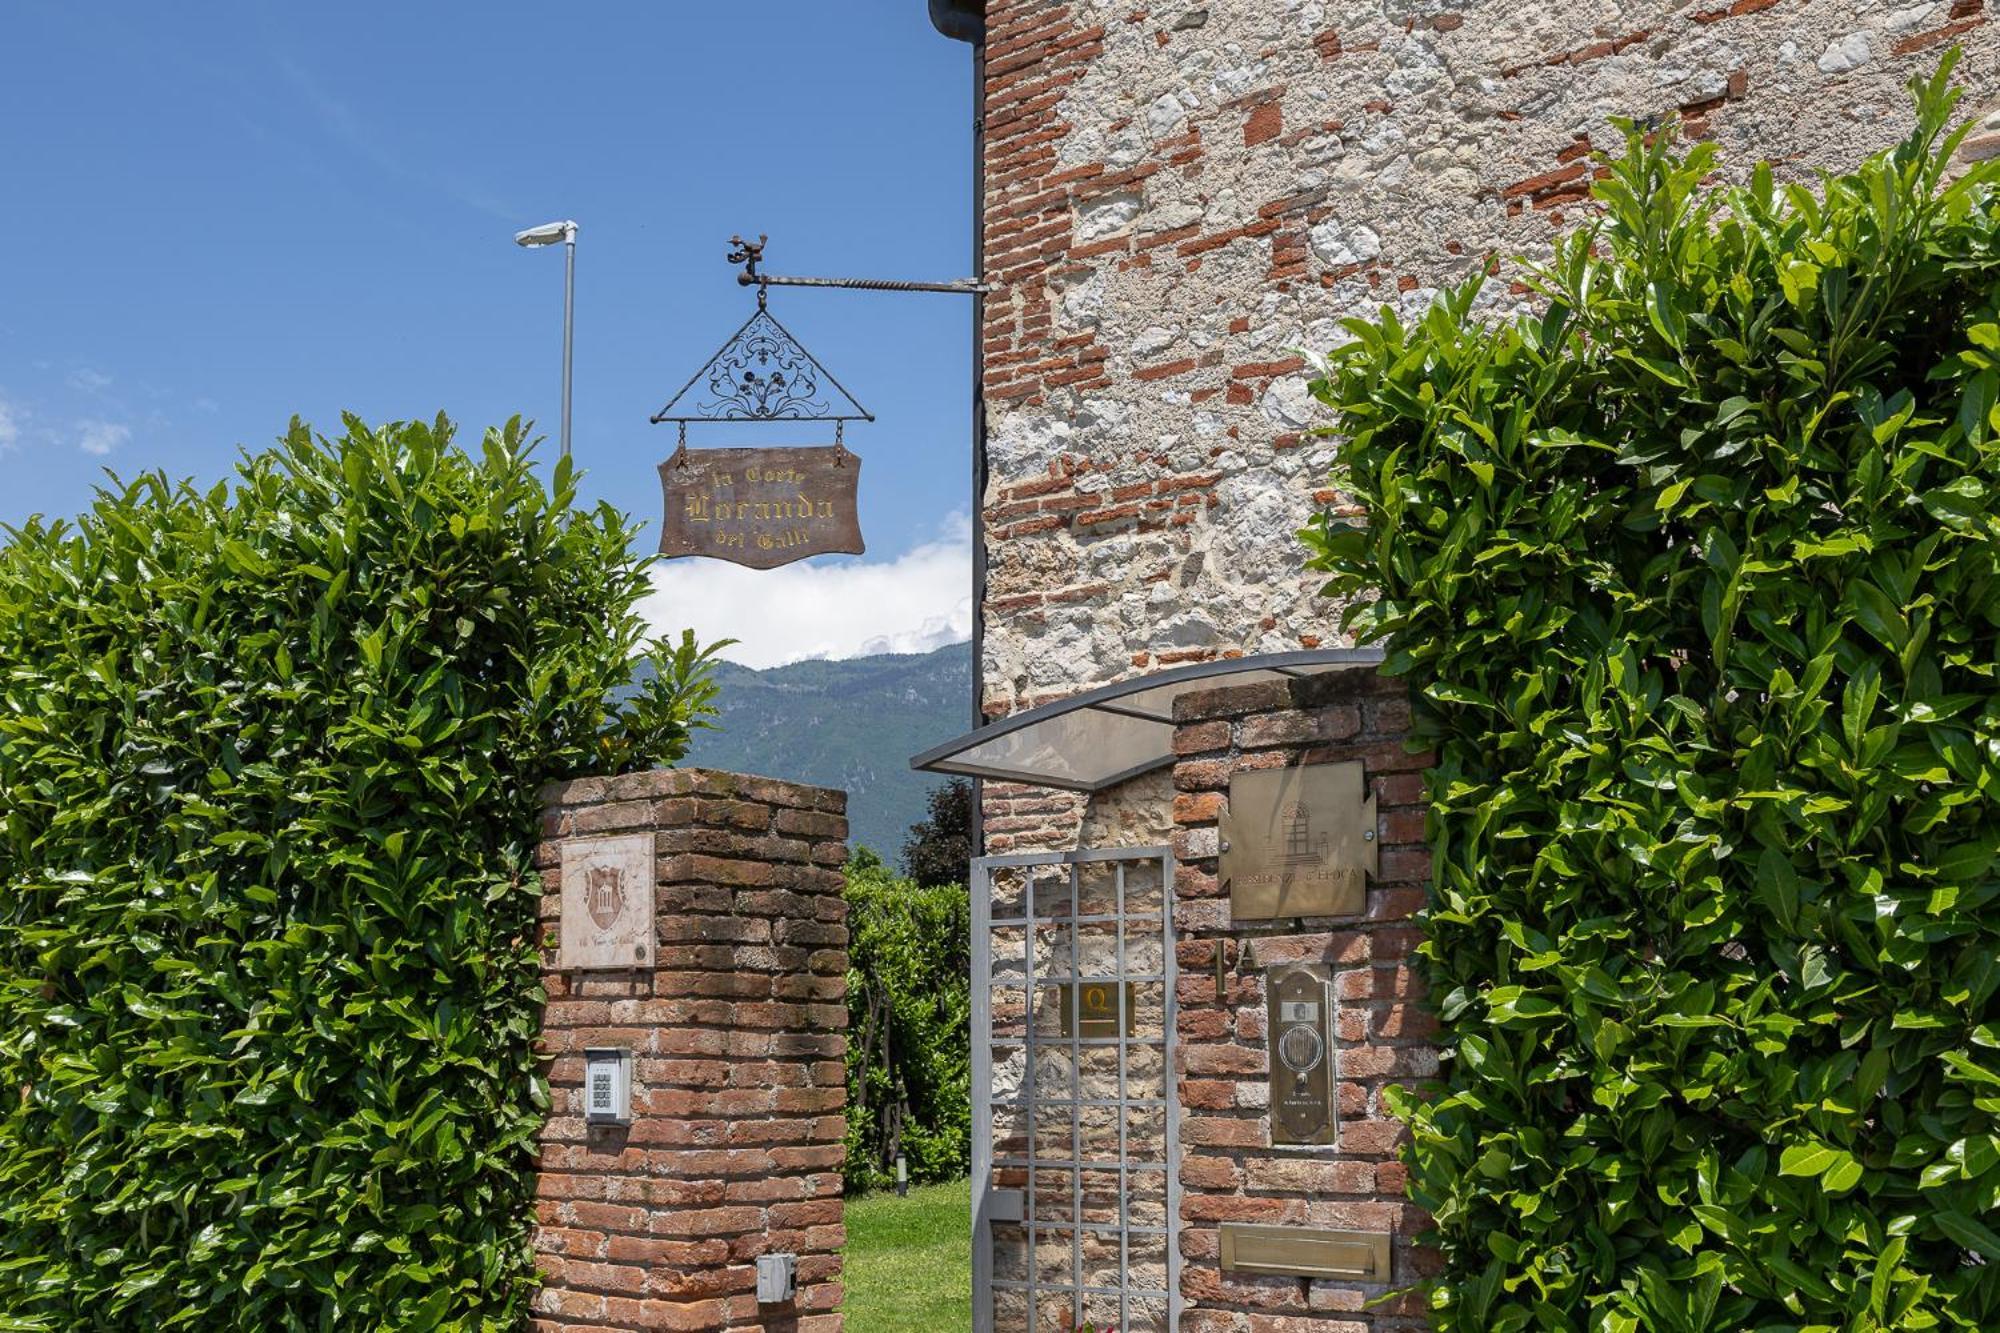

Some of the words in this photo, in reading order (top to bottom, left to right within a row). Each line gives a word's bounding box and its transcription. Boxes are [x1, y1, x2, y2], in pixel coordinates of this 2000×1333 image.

[746, 467, 806, 484] Corte
[685, 491, 833, 522] Locanda
[715, 530, 745, 548] dei
[757, 527, 810, 549] Galli
[1087, 988, 1111, 1012] Q
